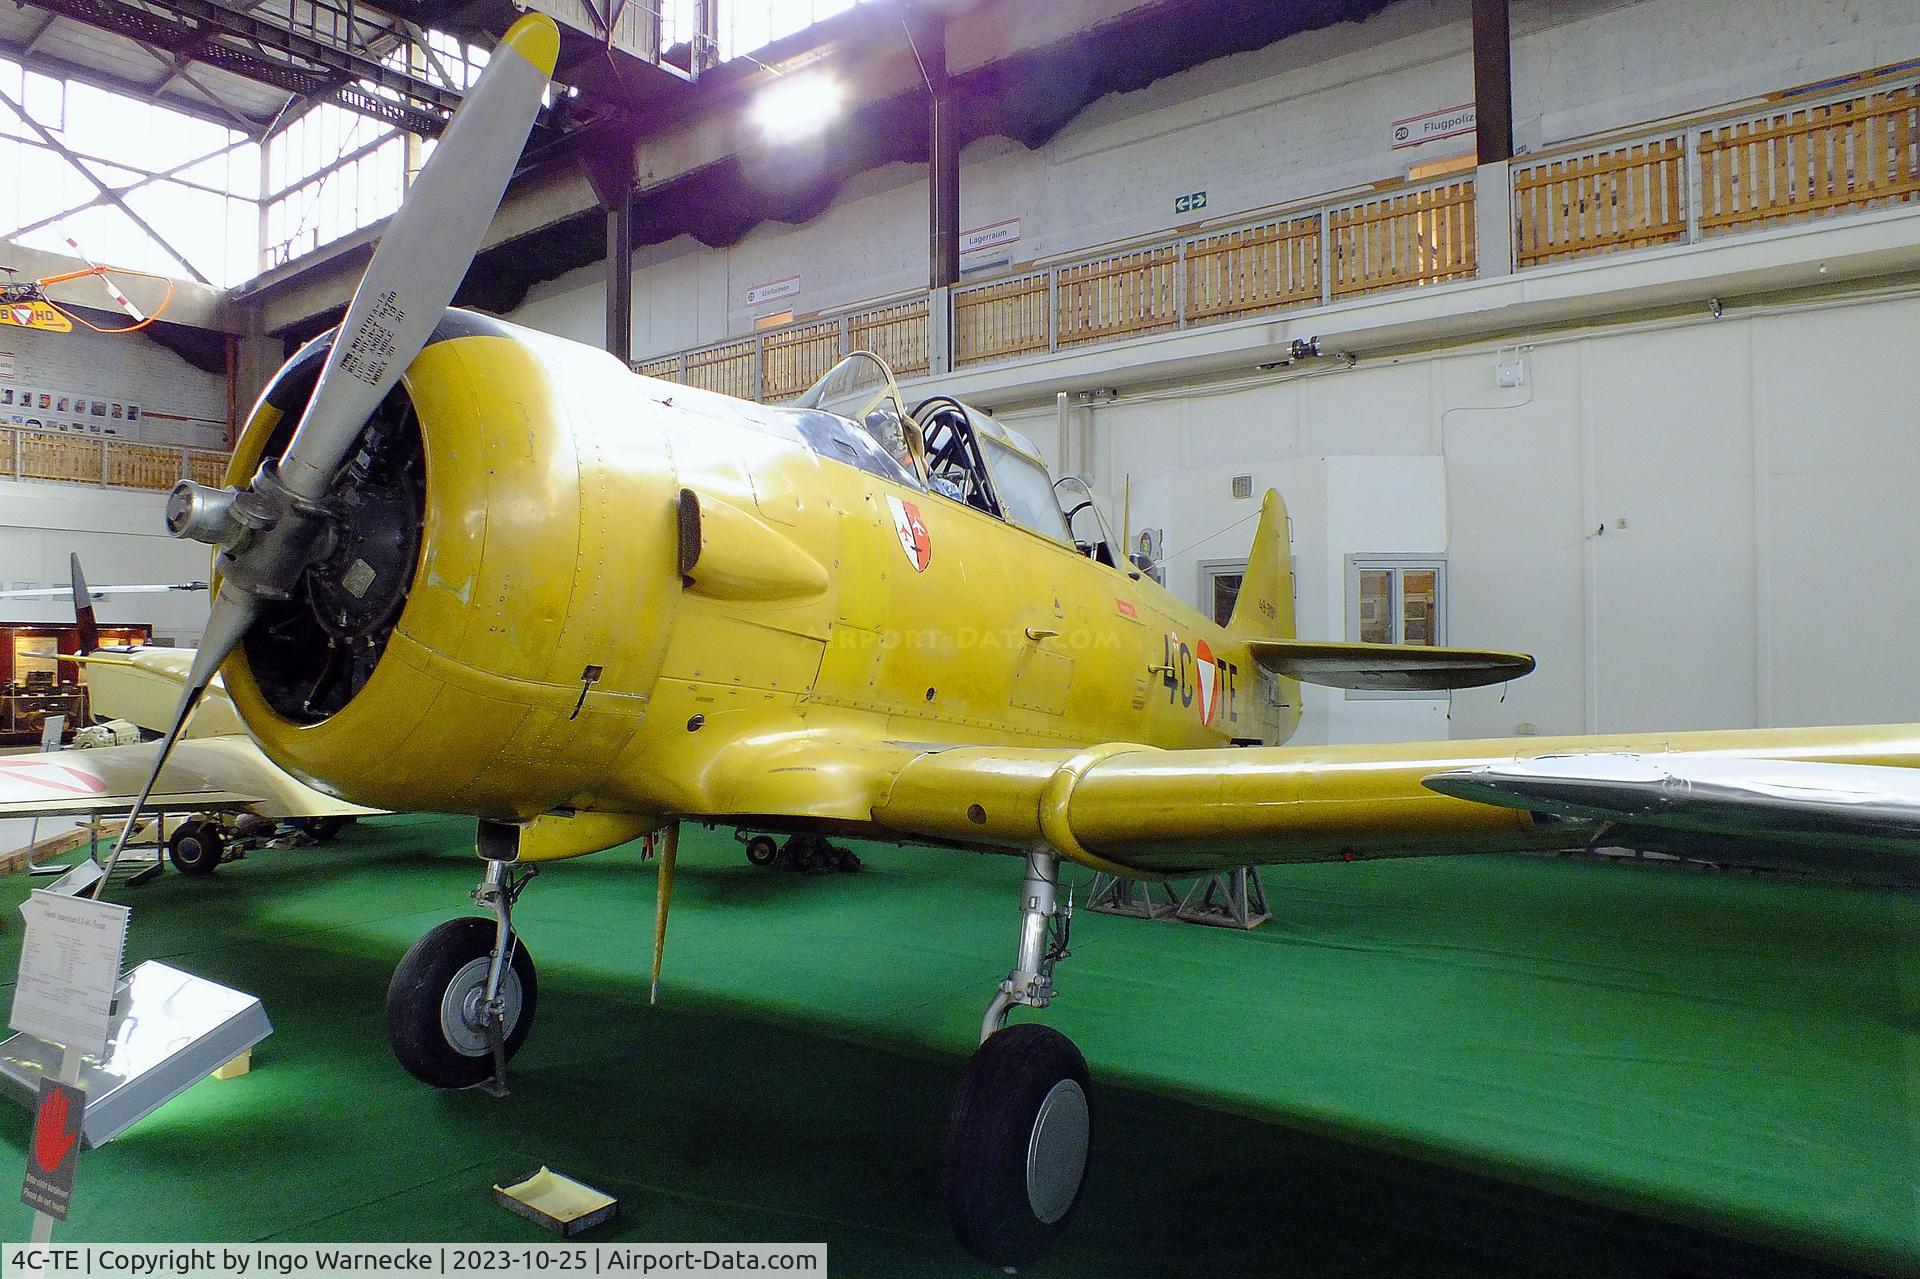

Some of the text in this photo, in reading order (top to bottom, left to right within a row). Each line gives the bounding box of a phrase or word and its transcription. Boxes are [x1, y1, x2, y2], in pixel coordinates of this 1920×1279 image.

[1424, 113, 1476, 133] Flugpoliz
[969, 230, 1007, 244] Lagerraum
[1163, 634, 1238, 722] 4C TE
